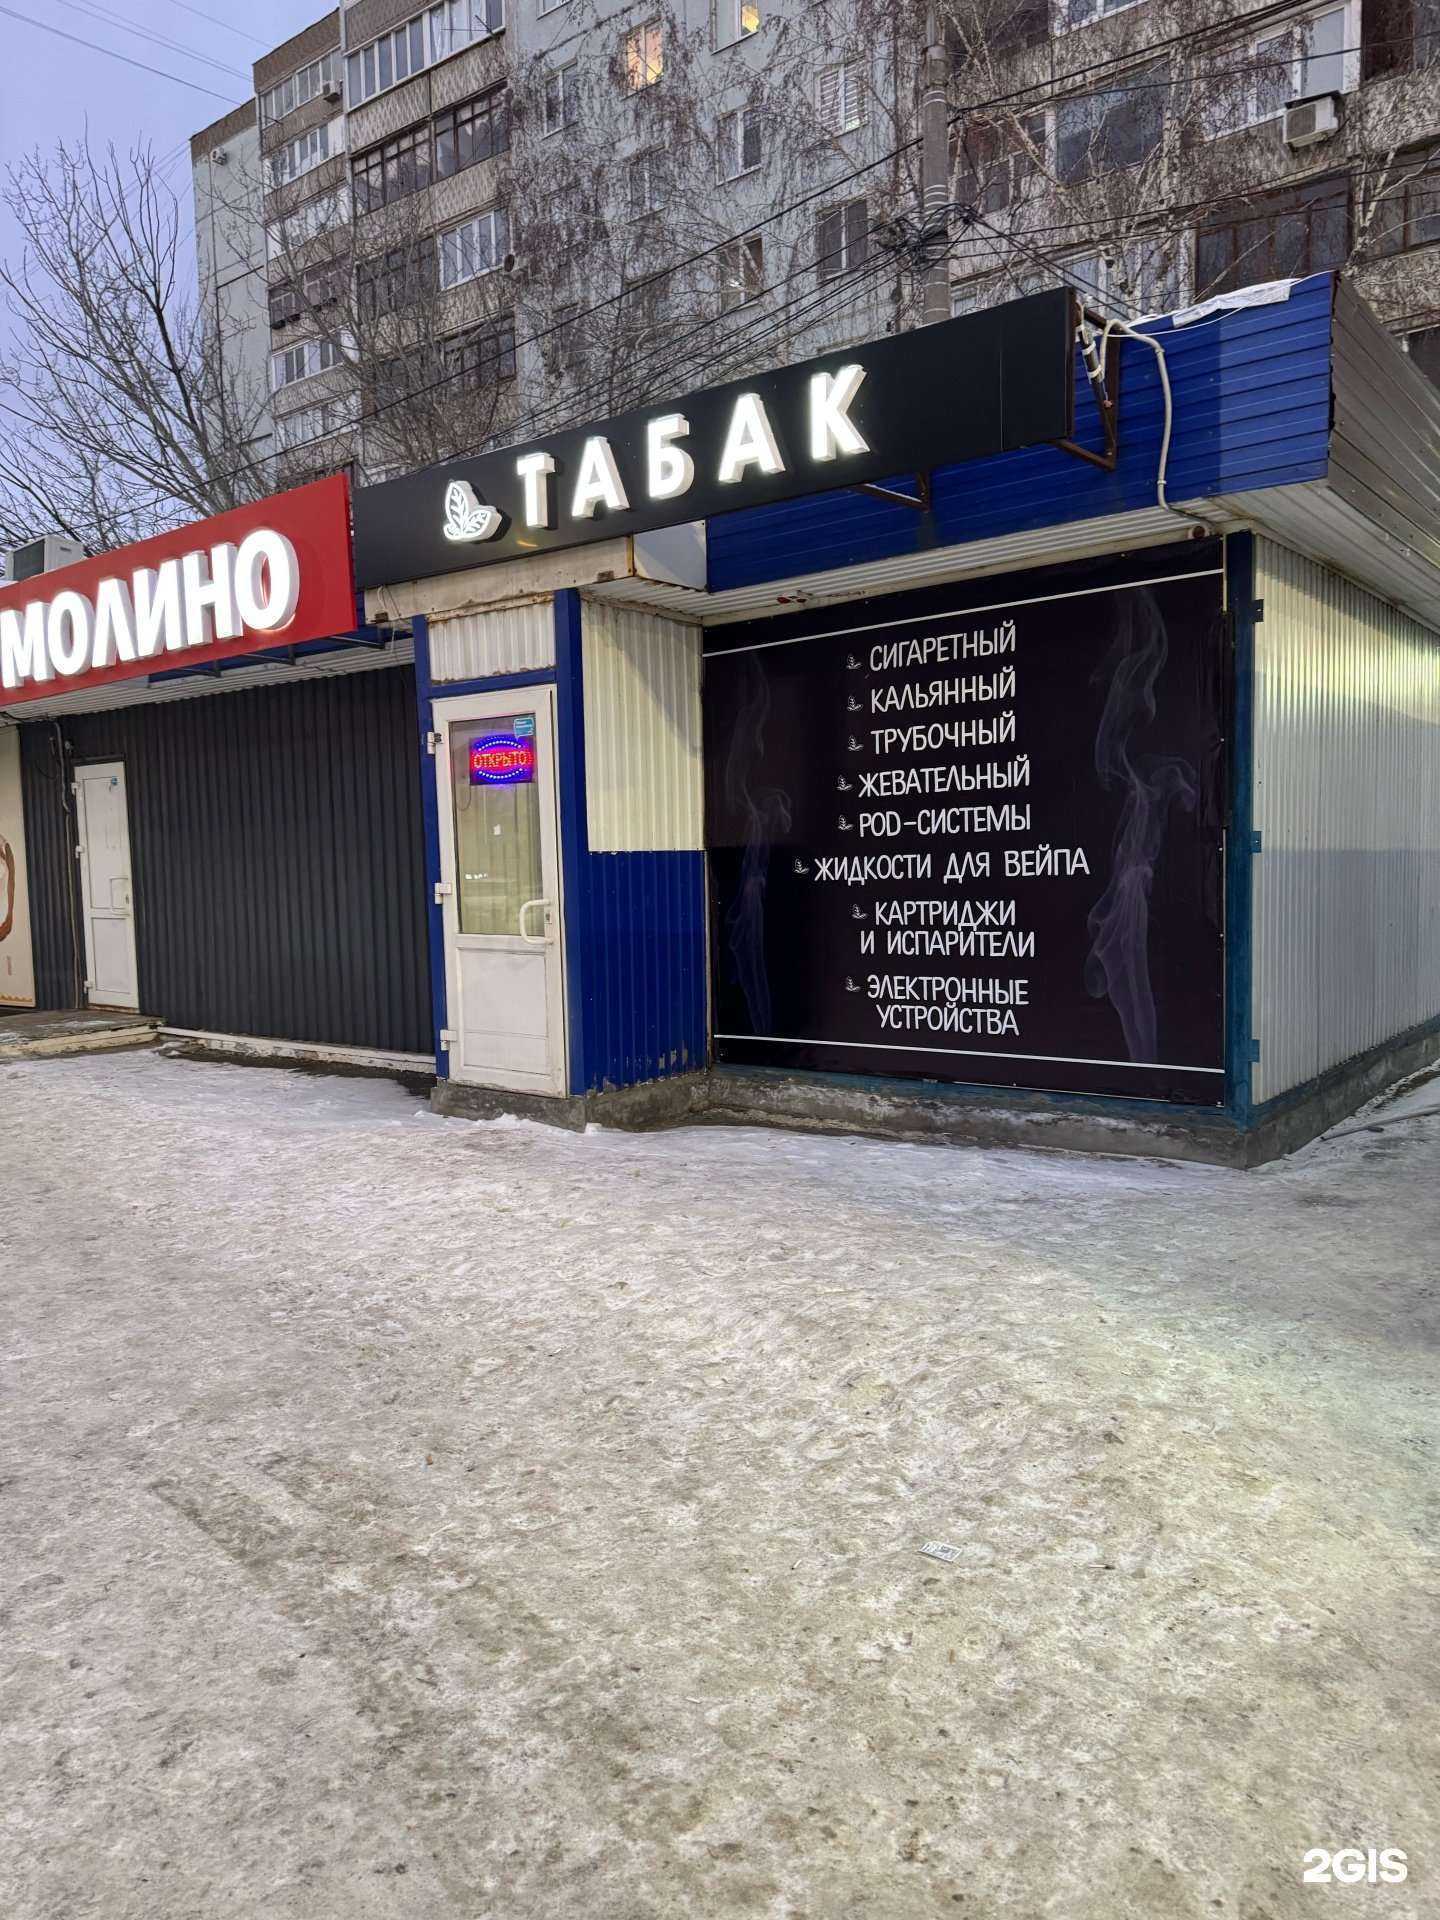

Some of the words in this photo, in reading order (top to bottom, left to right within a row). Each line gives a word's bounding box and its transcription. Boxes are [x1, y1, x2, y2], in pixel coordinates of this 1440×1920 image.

[516, 365, 869, 528] ТАБАК
[0, 529, 300, 688] МОЛИНО
[869, 619, 1016, 671] СИГАРЕТНЫЙ
[870, 665, 1016, 714] КАЛЬЯННЫЙ
[871, 710, 1016, 755] ТРУБОЧНЫЙ
[473, 751, 529, 769] ОТКРЫТО
[858, 754, 1030, 798] ЖЕВАТЕЛЬНЫЙ
[859, 804, 1031, 838] POD-СИСТЕМЫ
[814, 854, 932, 886] ЖИДКОСТИ
[943, 852, 990, 884] ДЛЯ
[1003, 845, 1091, 877] ВЕЙПА
[875, 900, 1016, 930] КАРТРИДЖИ
[860, 930, 875, 955] И
[886, 930, 1035, 958] ИСПАРИТЕЛИ
[867, 975, 1029, 1005] ЭЛЕКТРОННЫЕ
[876, 1002, 1020, 1036] УСТРОЙСТВА
